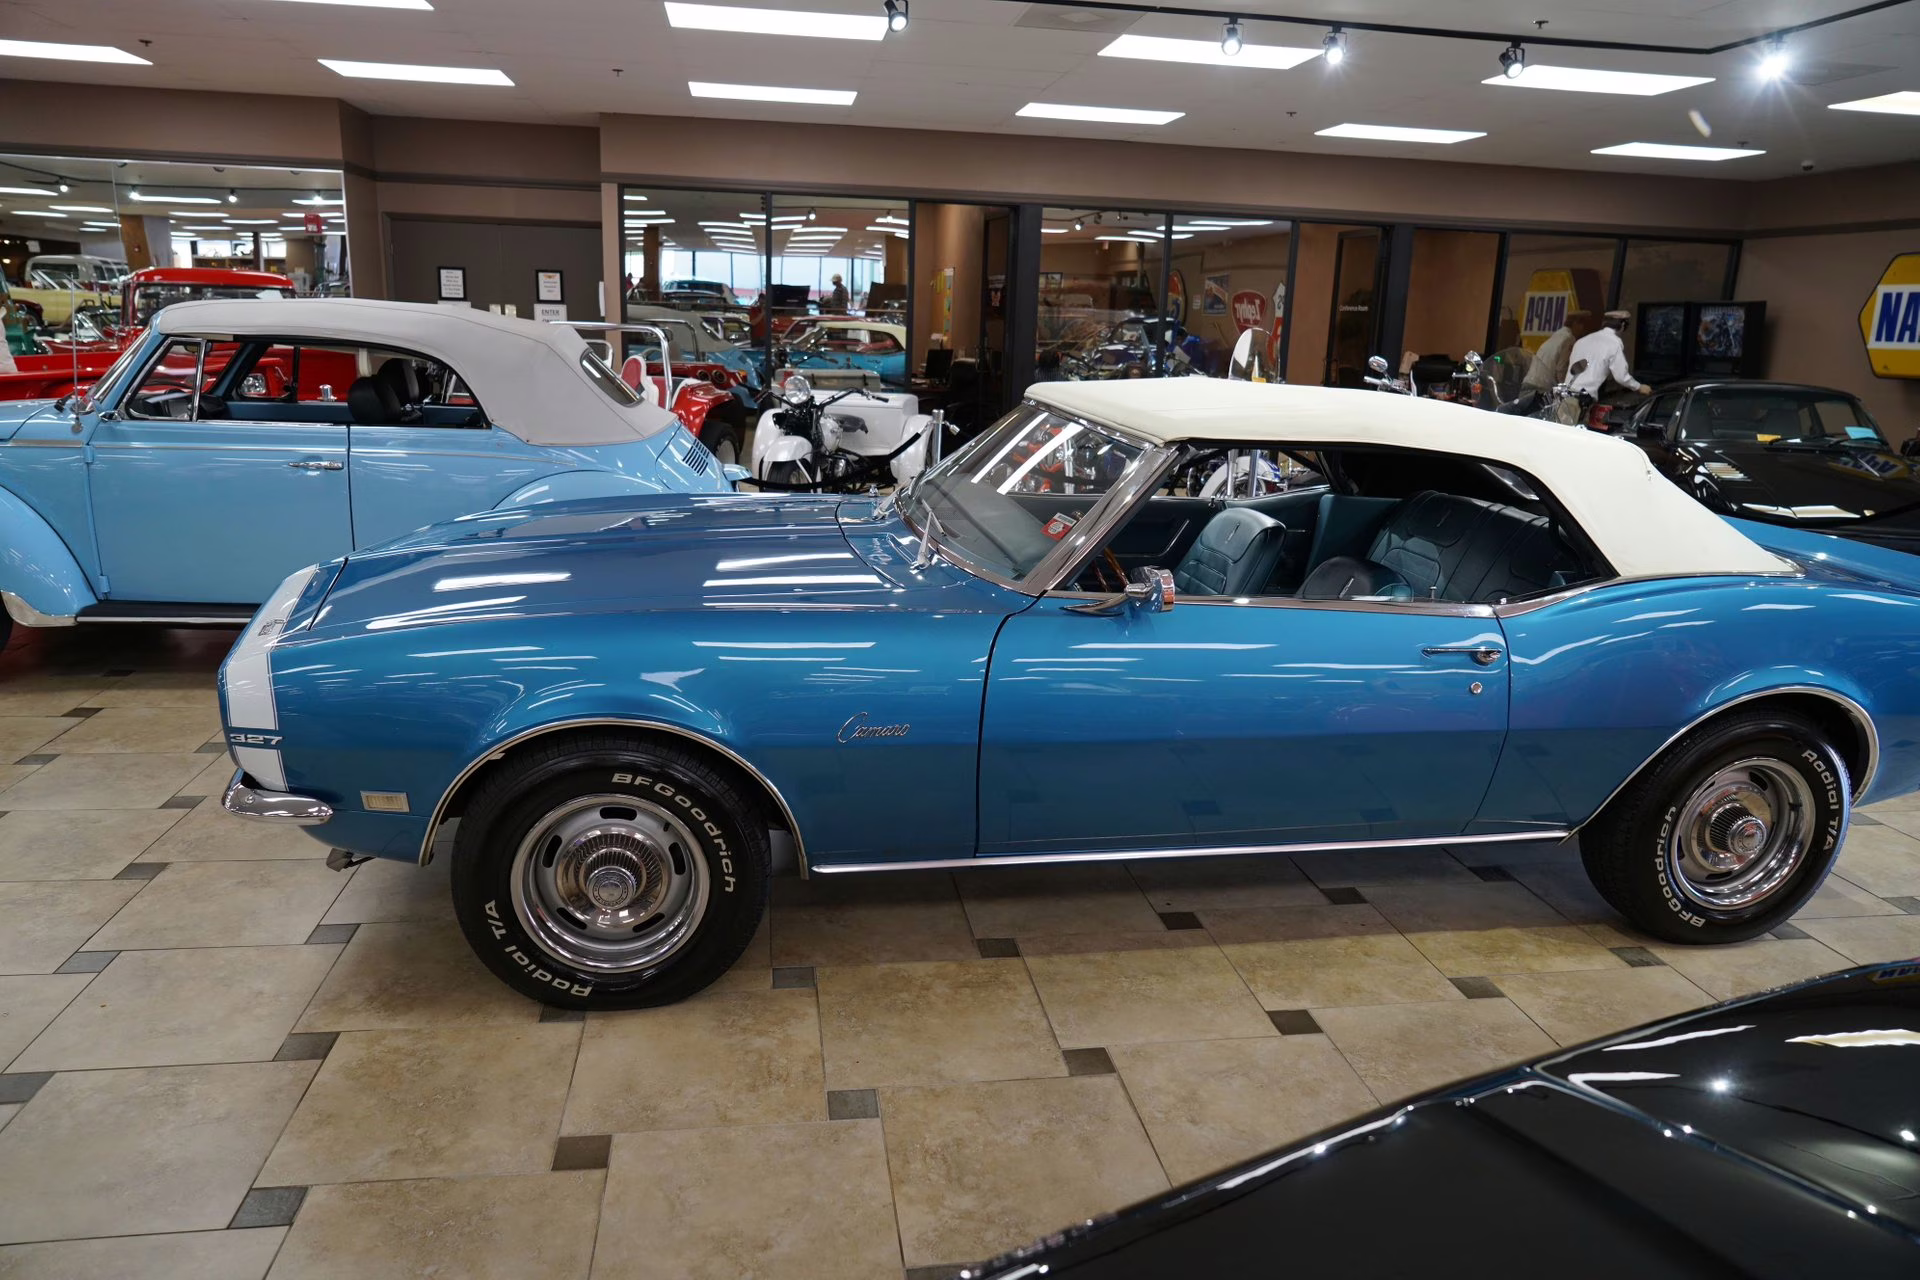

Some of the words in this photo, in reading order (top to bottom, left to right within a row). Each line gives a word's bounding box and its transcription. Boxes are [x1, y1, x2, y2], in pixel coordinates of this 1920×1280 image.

[1875, 292, 1920, 343] NA
[230, 733, 282, 745] 327
[838, 711, 910, 743] Camaro
[1802, 749, 1838, 810] Radial
[1822, 816, 1840, 851] T/A
[611, 773, 736, 893] BFGoodrich
[1654, 806, 1706, 928] BFGoodrich
[484, 899, 509, 941] T/A
[504, 945, 593, 997] Radial
